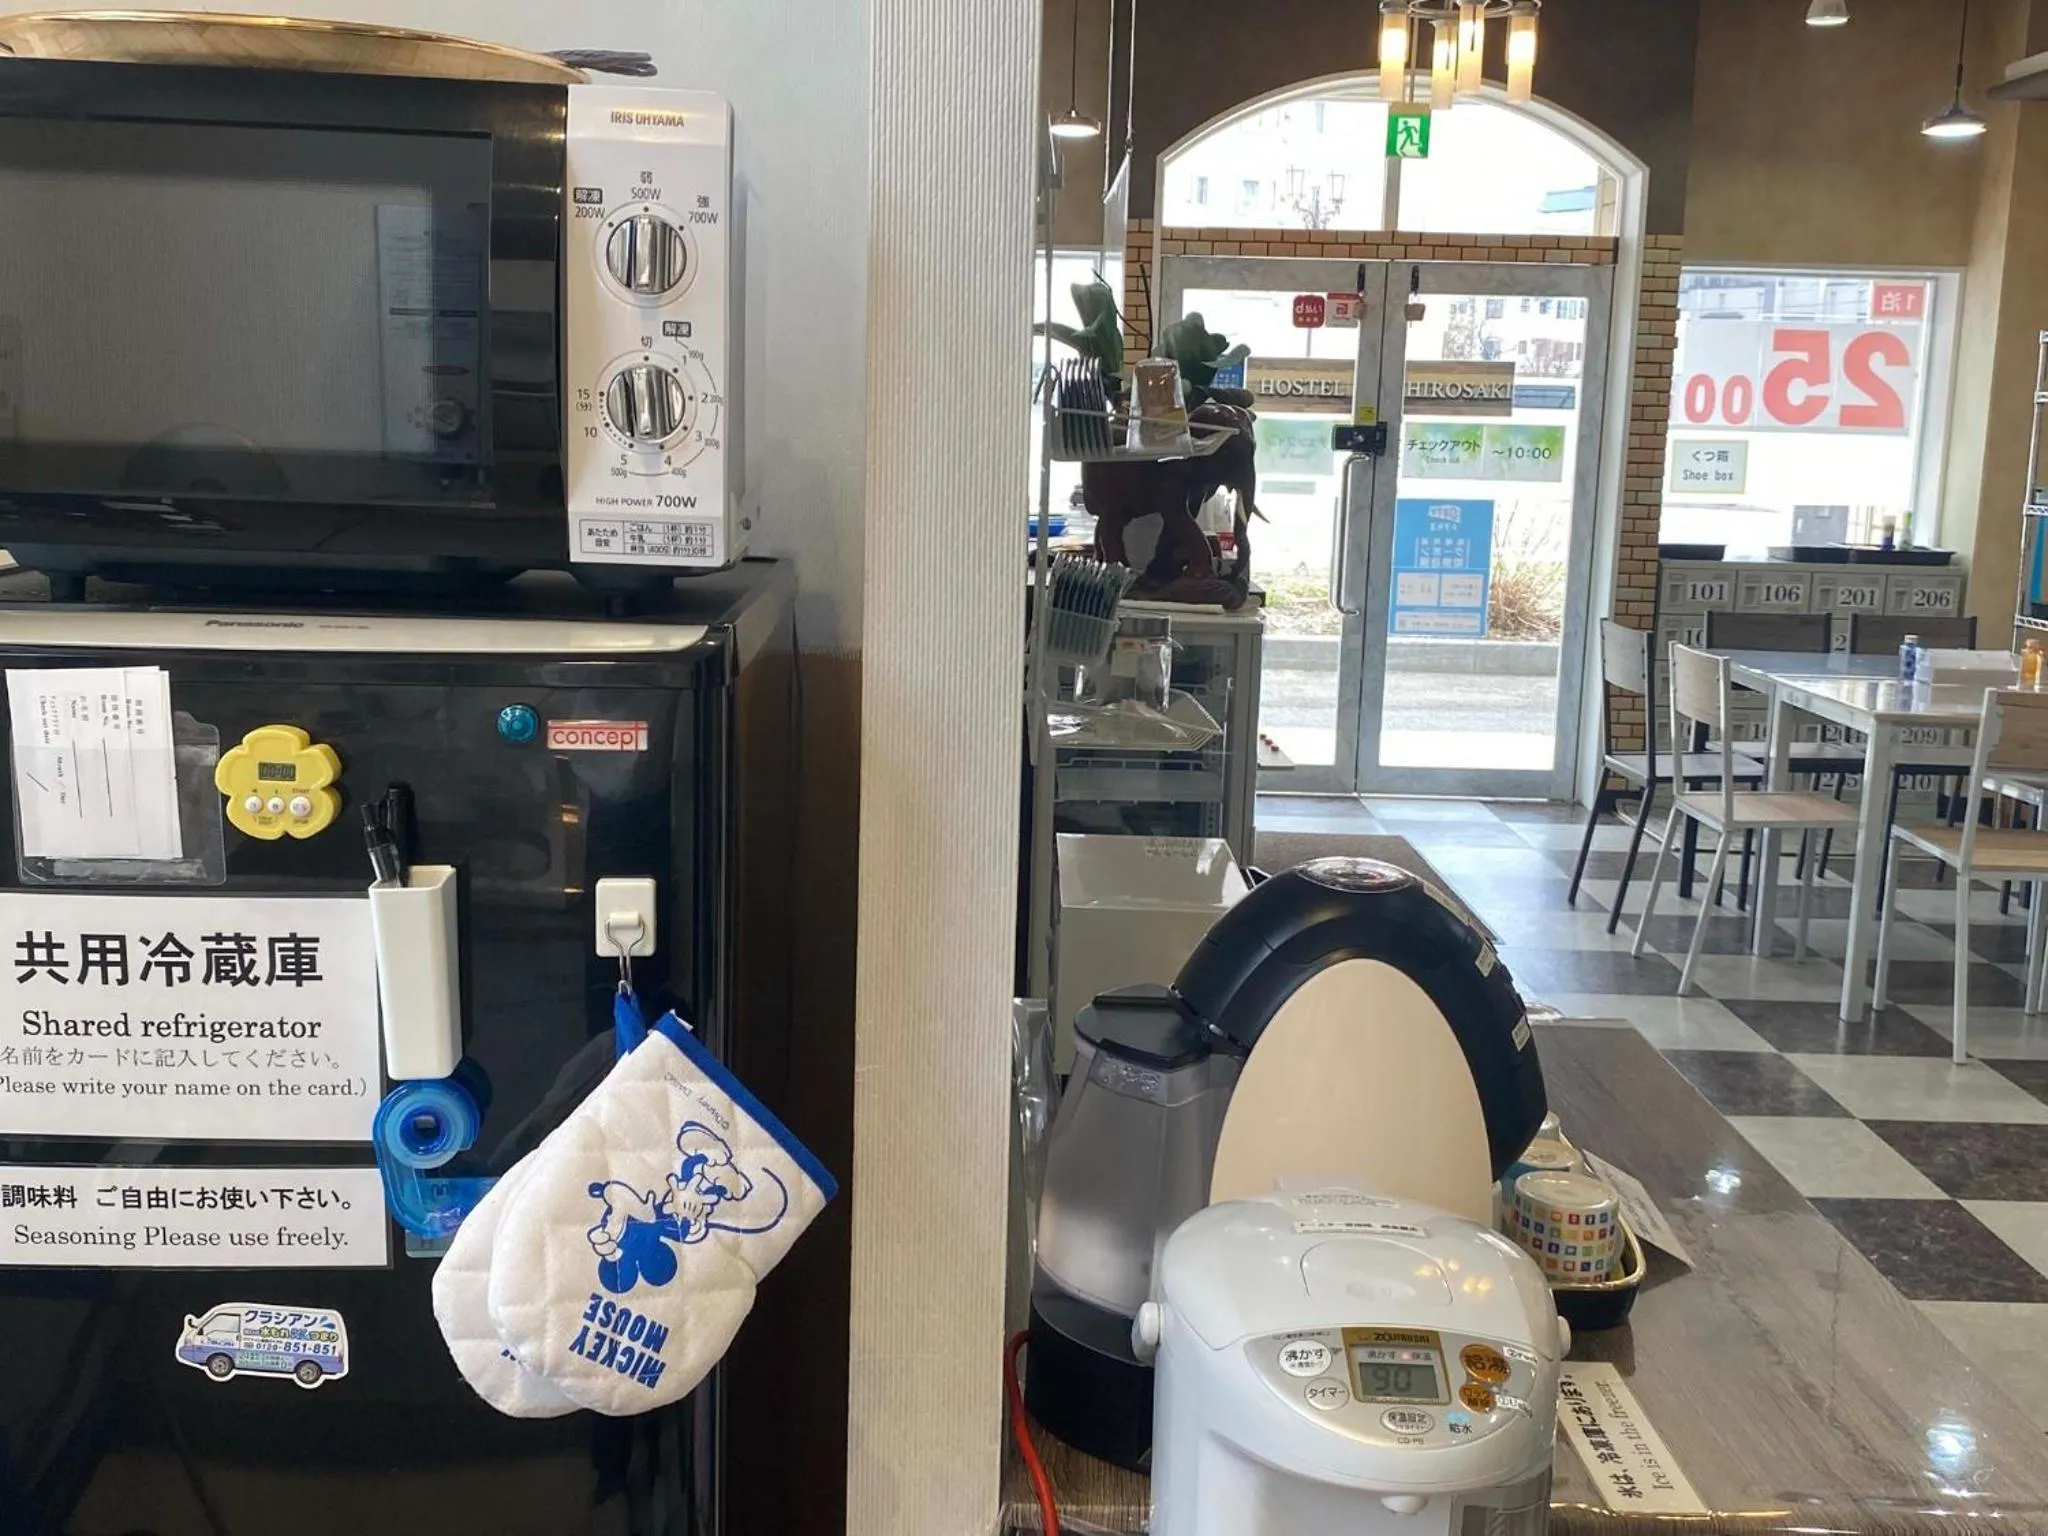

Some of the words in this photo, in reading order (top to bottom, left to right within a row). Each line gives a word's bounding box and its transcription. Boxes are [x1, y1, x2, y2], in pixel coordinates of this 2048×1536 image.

[611, 111, 633, 124] IRIS
[631, 187, 661, 200] 500W
[575, 206, 605, 218] 200W
[688, 211, 719, 224] 700W
[577, 389, 590, 399] 15
[1260, 378, 1346, 397] HOSTEL
[1406, 381, 1511, 399] HIROSAKI
[702, 393, 708, 403] 2
[584, 427, 598, 437] 10
[696, 431, 703, 442] 3
[1407, 438, 1482, 452] チェックアウト
[621, 456, 627, 466] 5
[664, 455, 671, 466] 4
[1692, 450, 1729, 462] くつ箱
[1682, 468, 1708, 480] Shoe
[1714, 470, 1734, 480] box
[621, 497, 652, 506] POWER
[656, 495, 697, 508] 700W
[1689, 583, 1725, 600] 101
[1764, 584, 1800, 602] 106
[1840, 589, 1875, 606] 201
[1914, 590, 1950, 607] 206
[552, 724, 640, 750] concept
[1901, 727, 1937, 745] 209
[15, 931, 323, 988] 共用冷蔵庫
[22, 1010, 131, 1037] Shared
[141, 1013, 322, 1043] refrigerator
[0, 1045, 342, 1070] 名前をカードに記入してください。
[62, 1078, 116, 1094] write
[122, 1083, 167, 1097] your
[174, 1083, 230, 1098] name
[236, 1084, 262, 1098] on
[268, 1080, 301, 1097] the
[307, 1077, 368, 1099] card.)
[1, 1185, 77, 1209] 調味料
[96, 1185, 352, 1210] ご自由にお使い下さい。
[14, 1225, 136, 1249] Seasoning
[144, 1226, 221, 1247] Please
[229, 1230, 269, 1247] use
[276, 1226, 349, 1250] freely.
[245, 1310, 318, 1327] クラシアン
[582, 1292, 669, 1354] MOUSE
[569, 1325, 666, 1389] MICKEY
[1372, 1366, 1412, 1392] 90
[1308, 1387, 1346, 1399] タイマー
[1449, 1422, 1472, 1434] 給水
[1620, 1421, 1642, 1440] the
[1632, 1443, 1652, 1455] in
[1640, 1458, 1660, 1469] is
[1651, 1471, 1676, 1490] Ice
